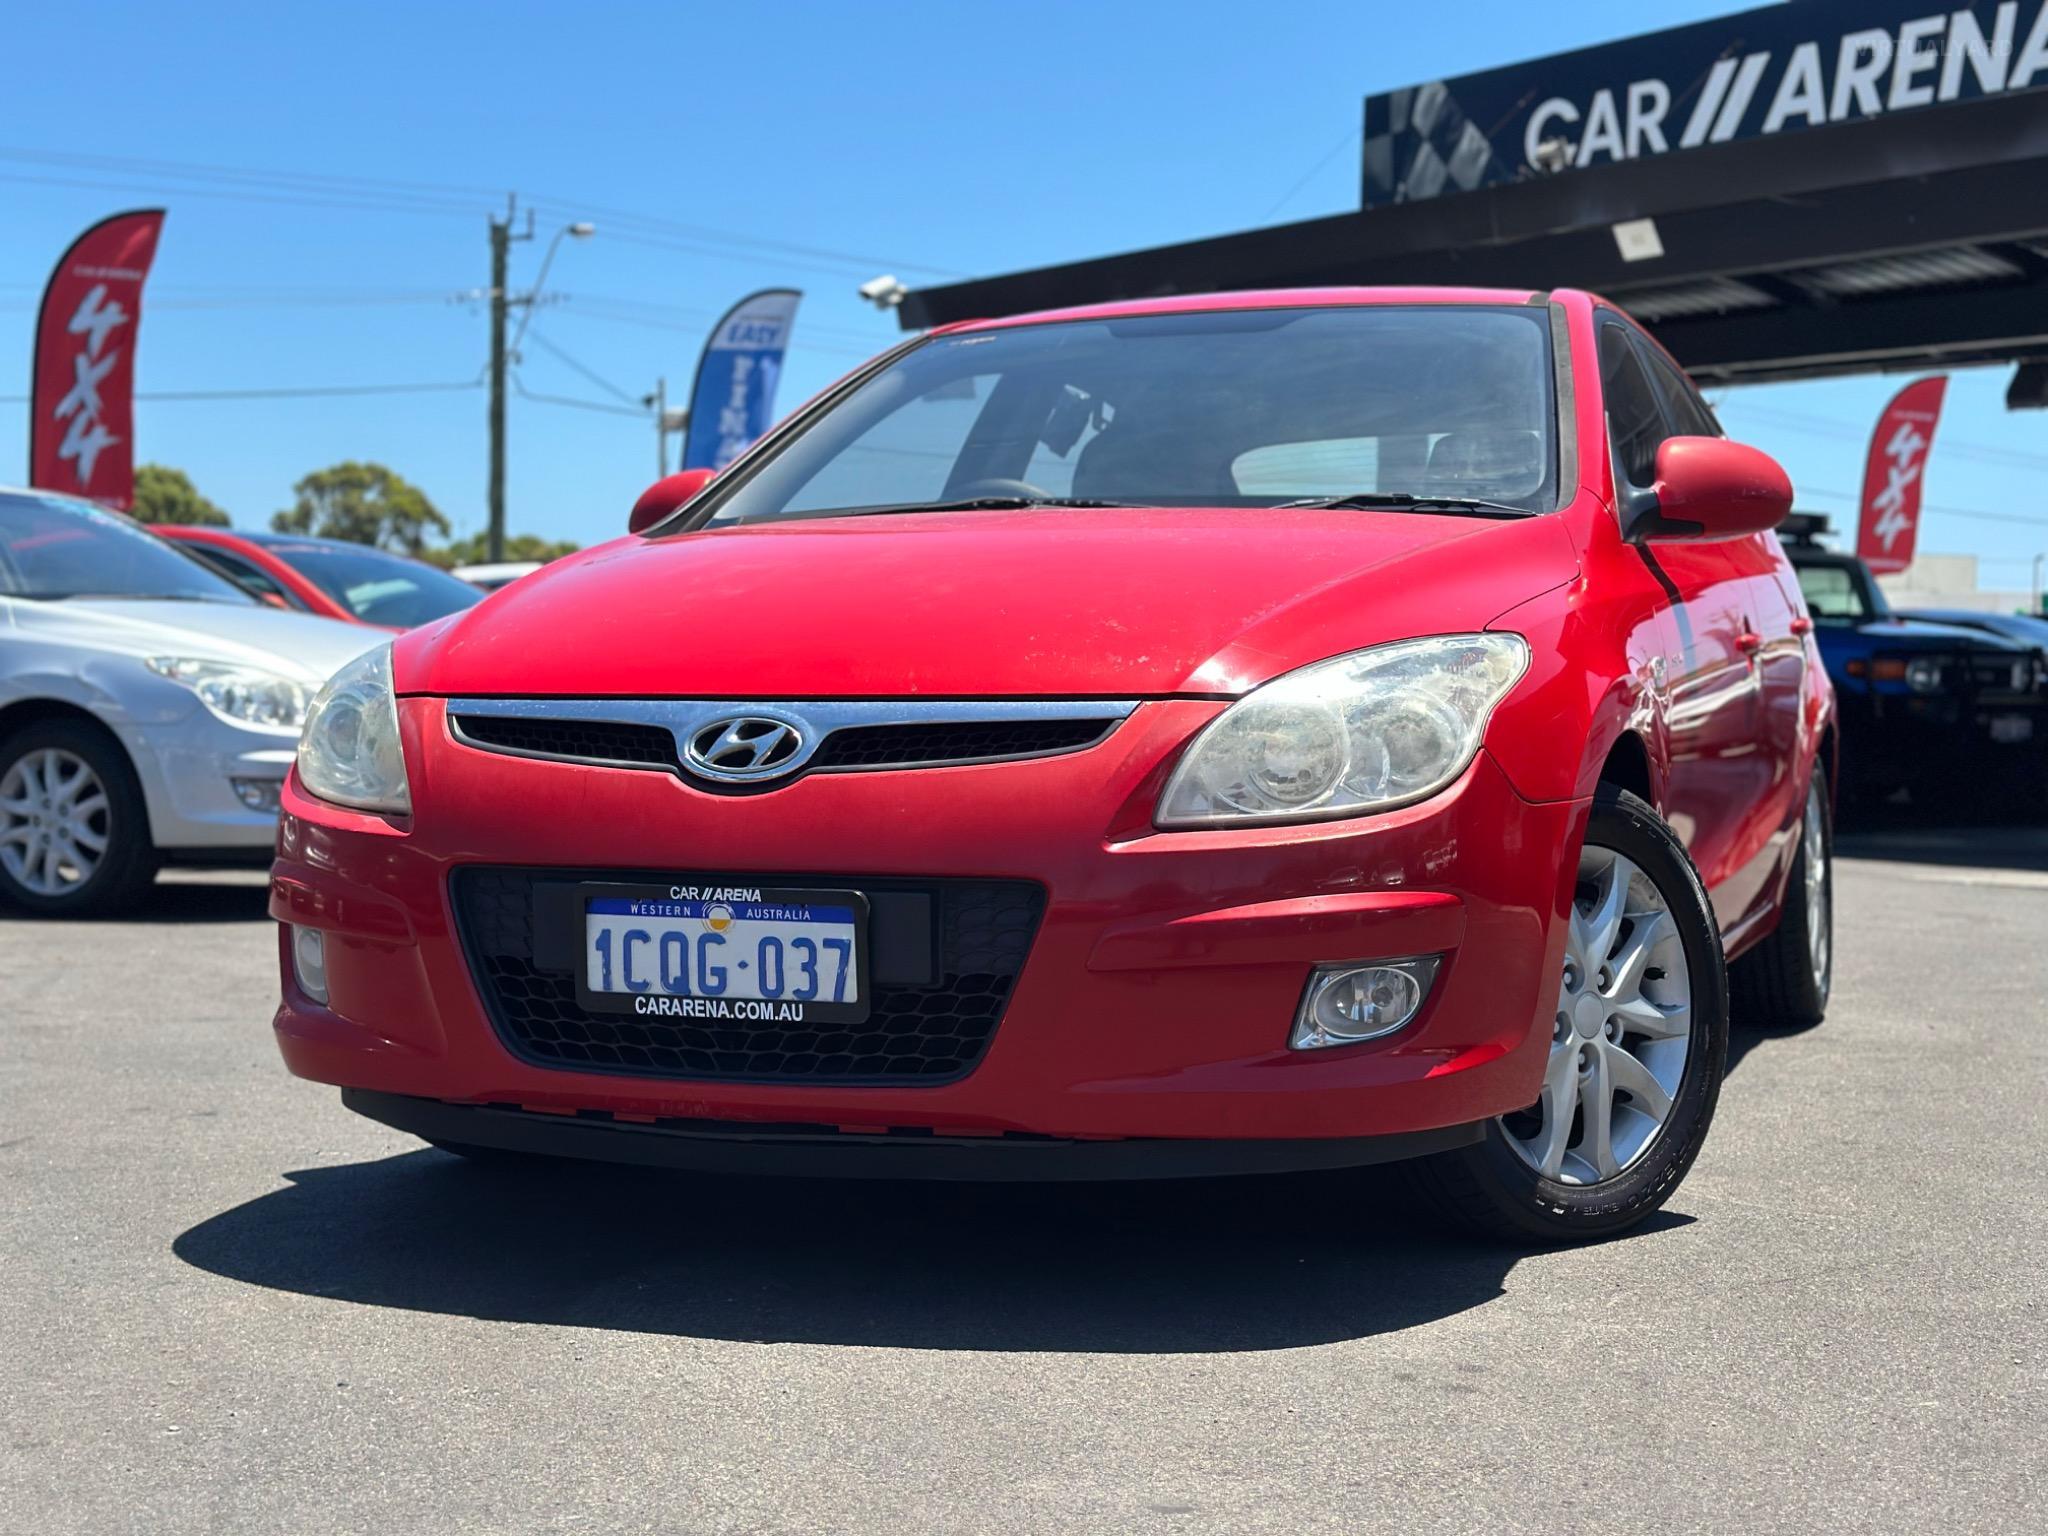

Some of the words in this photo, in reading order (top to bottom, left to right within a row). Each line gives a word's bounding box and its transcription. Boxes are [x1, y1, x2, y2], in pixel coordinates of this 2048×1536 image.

[1524, 79, 1669, 169] CAR
[670, 886, 699, 901] CAR
[713, 888, 762, 902] ARENA
[630, 904, 691, 917] WESTERN
[746, 908, 811, 921] AUSTRALIA
[635, 996, 804, 1022] CARARENA.COM.AU
